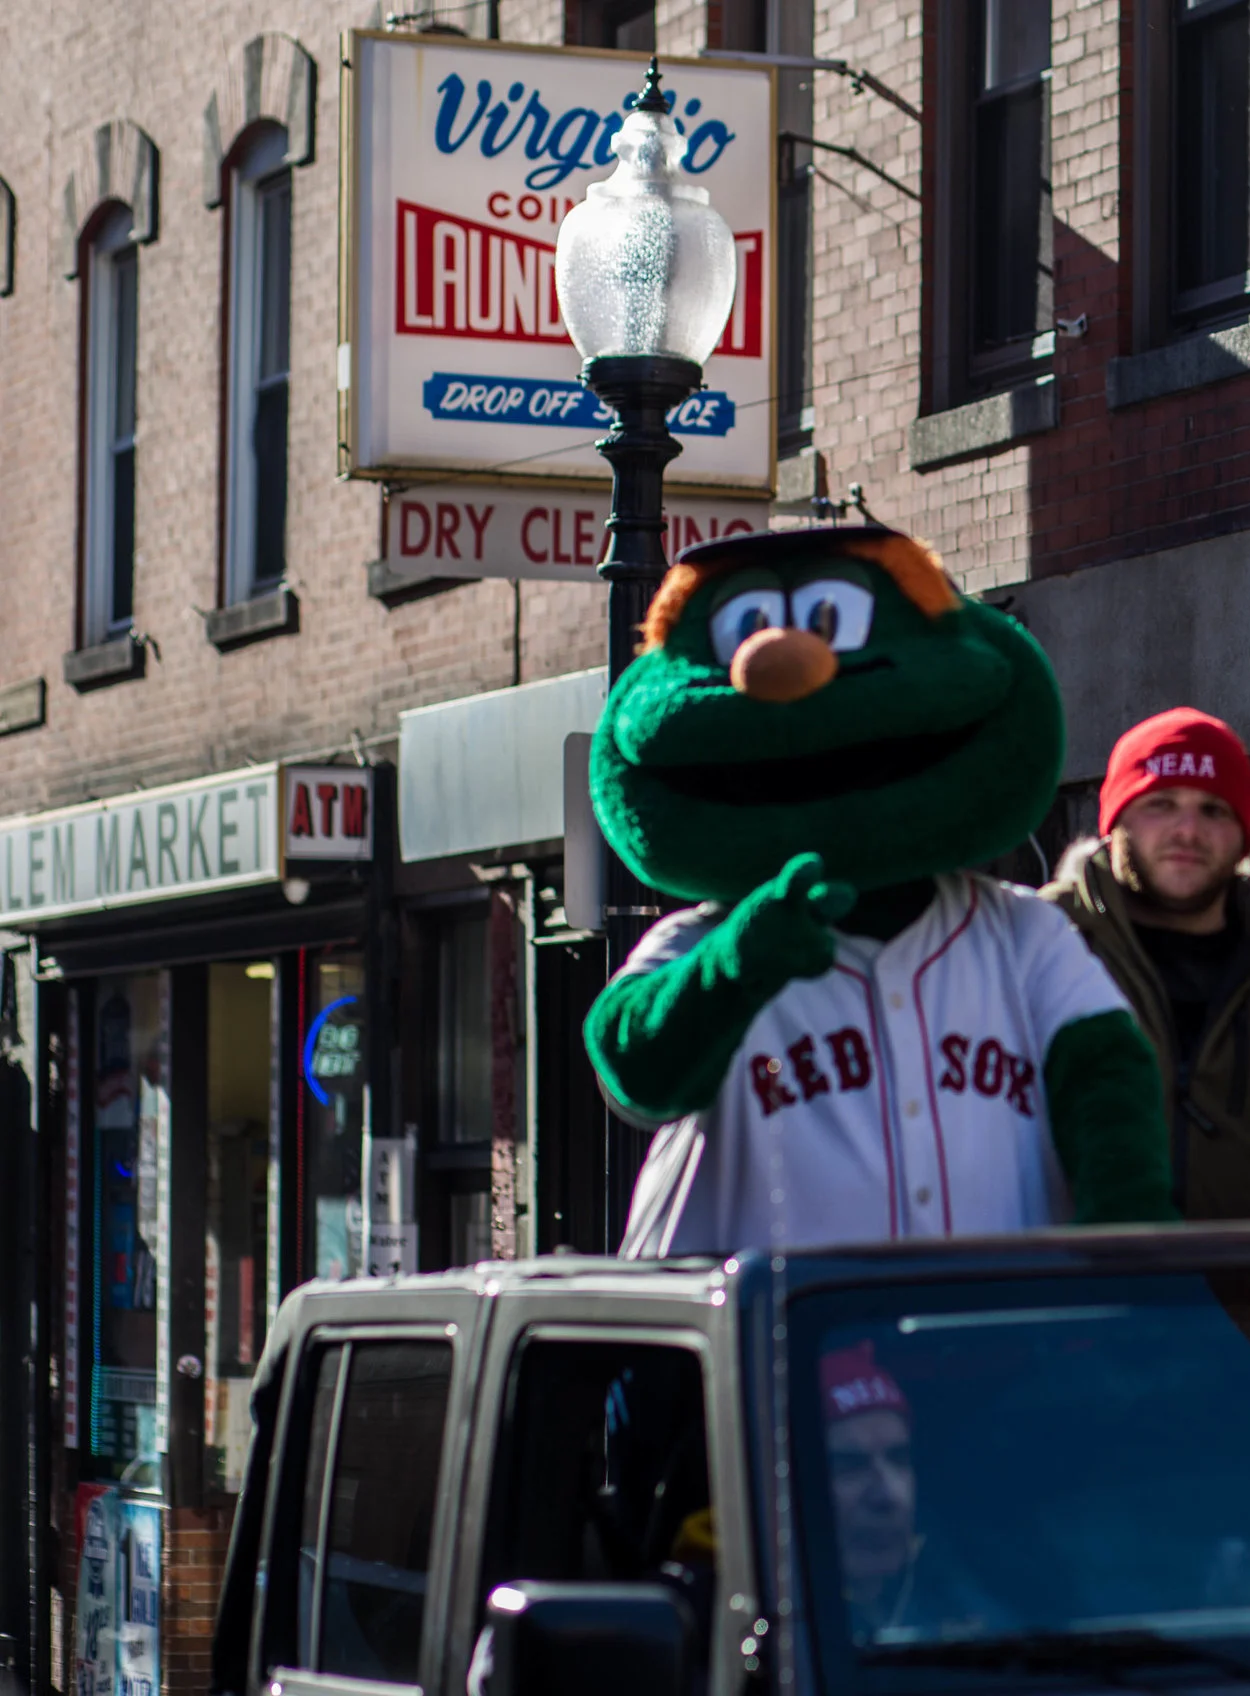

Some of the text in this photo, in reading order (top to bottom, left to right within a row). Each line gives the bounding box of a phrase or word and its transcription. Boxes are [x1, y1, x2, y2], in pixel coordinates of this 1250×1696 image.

[434, 72, 736, 190] Virgio
[403, 209, 757, 350] LAUNDT
[439, 381, 720, 428] DROP OFF SICE
[400, 502, 494, 561] DRY
[0, 783, 269, 911] LEM MARKET
[290, 781, 367, 839] ATM
[751, 1026, 873, 1117] RED
